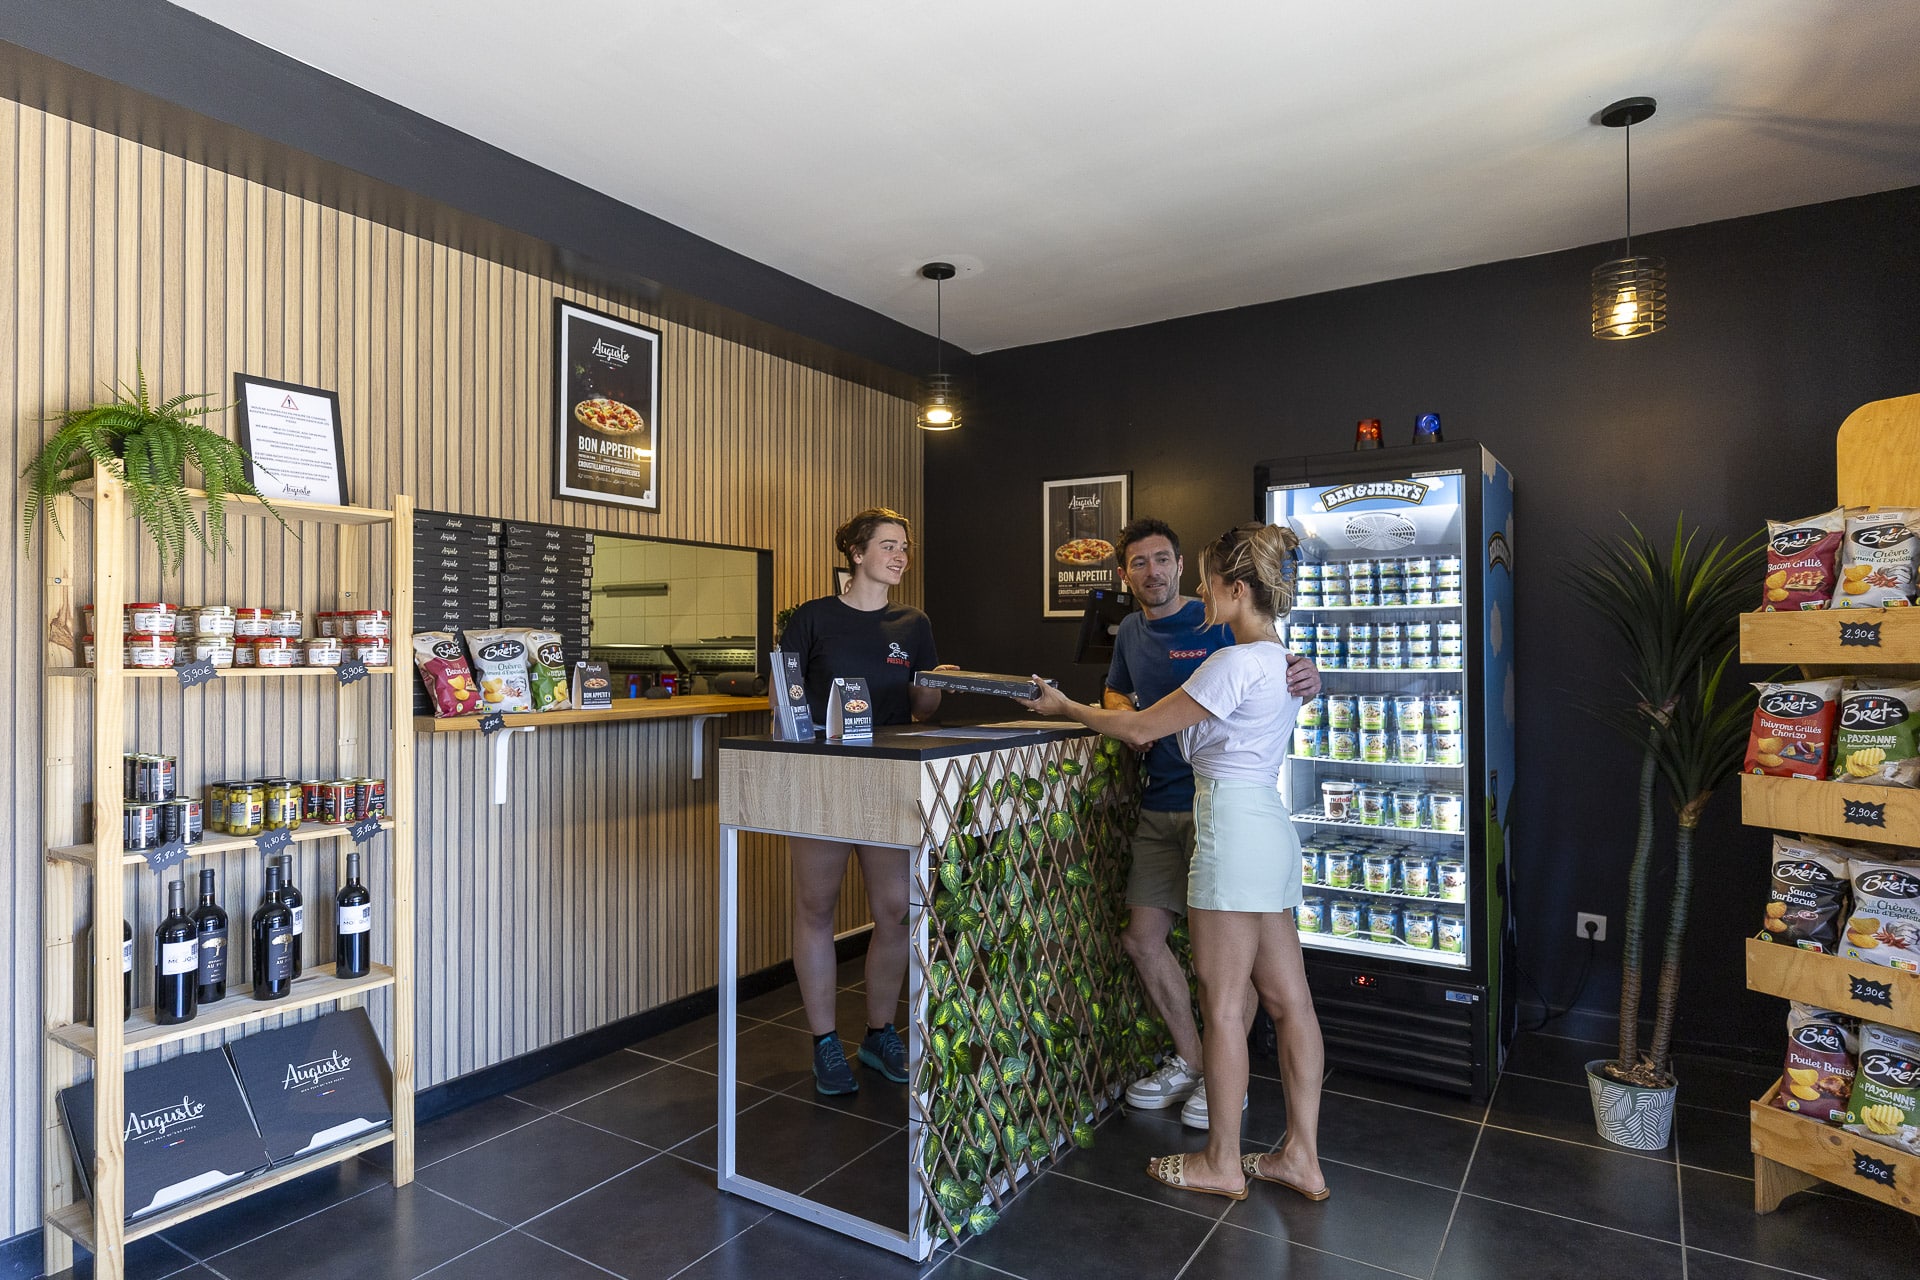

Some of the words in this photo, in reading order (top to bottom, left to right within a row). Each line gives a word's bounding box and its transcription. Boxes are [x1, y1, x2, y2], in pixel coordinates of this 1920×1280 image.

[592, 337, 630, 363] Augusto
[578, 435, 598, 453] BON
[600, 440, 636, 460] APPETIT
[1767, 562, 1792, 573] Bacon
[1792, 559, 1822, 568] Grillé
[1058, 571, 1074, 582] BON
[1076, 569, 1107, 581] APPETIT
[1760, 718, 1793, 731] Poivrons
[1795, 725, 1822, 734] Grillés
[1771, 728, 1807, 740] Chorizo
[1847, 734, 1897, 745] PAYSANNE
[1771, 890, 1817, 908] Barbecue
[1787, 885, 1818, 899] Sauce
[1877, 900, 1918, 915] Chèvre
[281, 1049, 352, 1090] Augusto
[1790, 1053, 1822, 1069] Poulet
[1823, 1061, 1856, 1078] Braisé
[1864, 1082, 1916, 1107] PAYSANNE
[123, 1095, 206, 1142] Augusto
